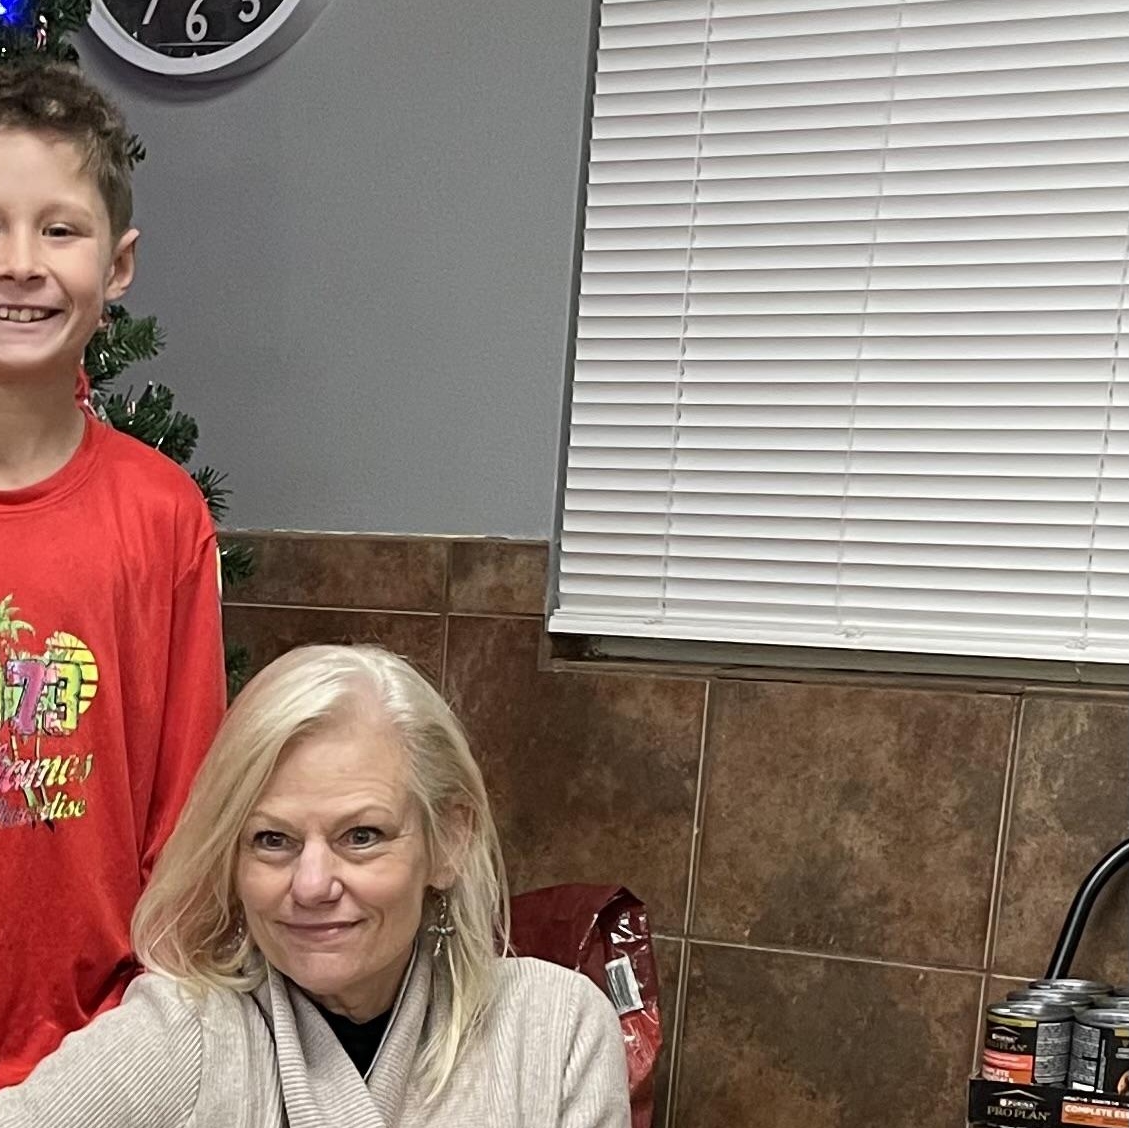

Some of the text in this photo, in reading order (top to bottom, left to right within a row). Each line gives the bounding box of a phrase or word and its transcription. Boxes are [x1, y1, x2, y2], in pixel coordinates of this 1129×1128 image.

[185, 0, 208, 42] 6
[987, 1105, 1048, 1121] PRO PLAN
[1065, 1104, 1114, 1118] COMPLETE
